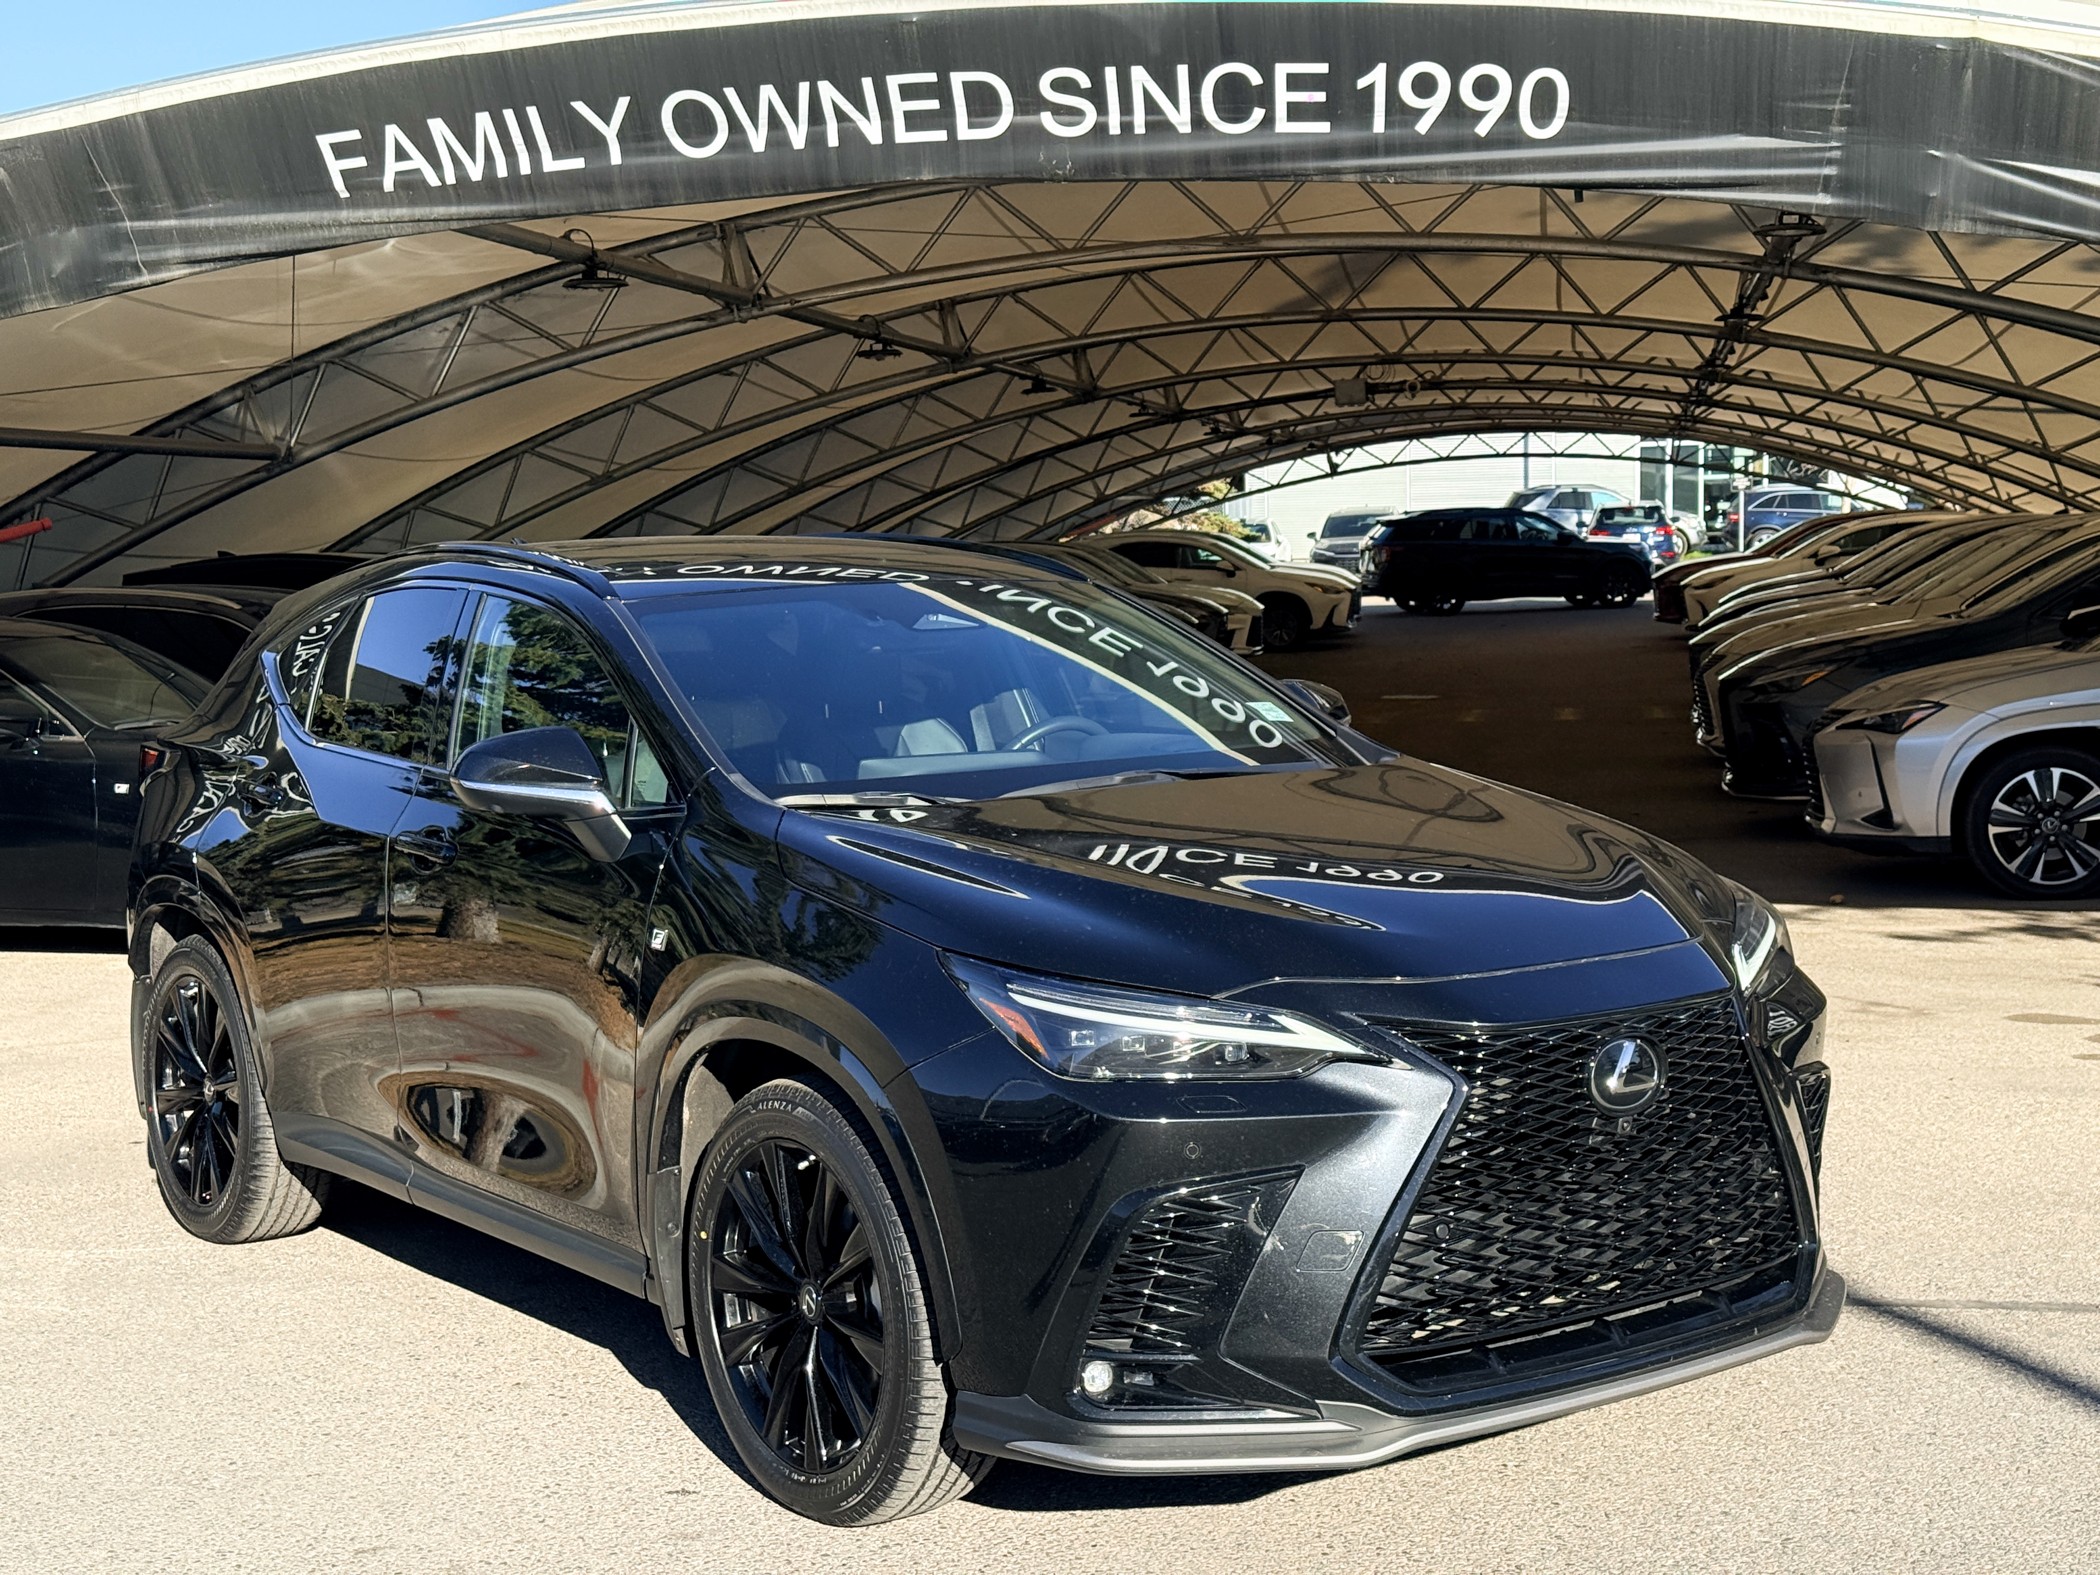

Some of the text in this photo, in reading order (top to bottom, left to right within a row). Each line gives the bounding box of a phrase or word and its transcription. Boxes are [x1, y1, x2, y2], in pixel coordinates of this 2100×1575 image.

[316, 61, 1570, 198] FAMILY OWNED SINCE 1990
[757, 1100, 792, 1112] ALENZA
